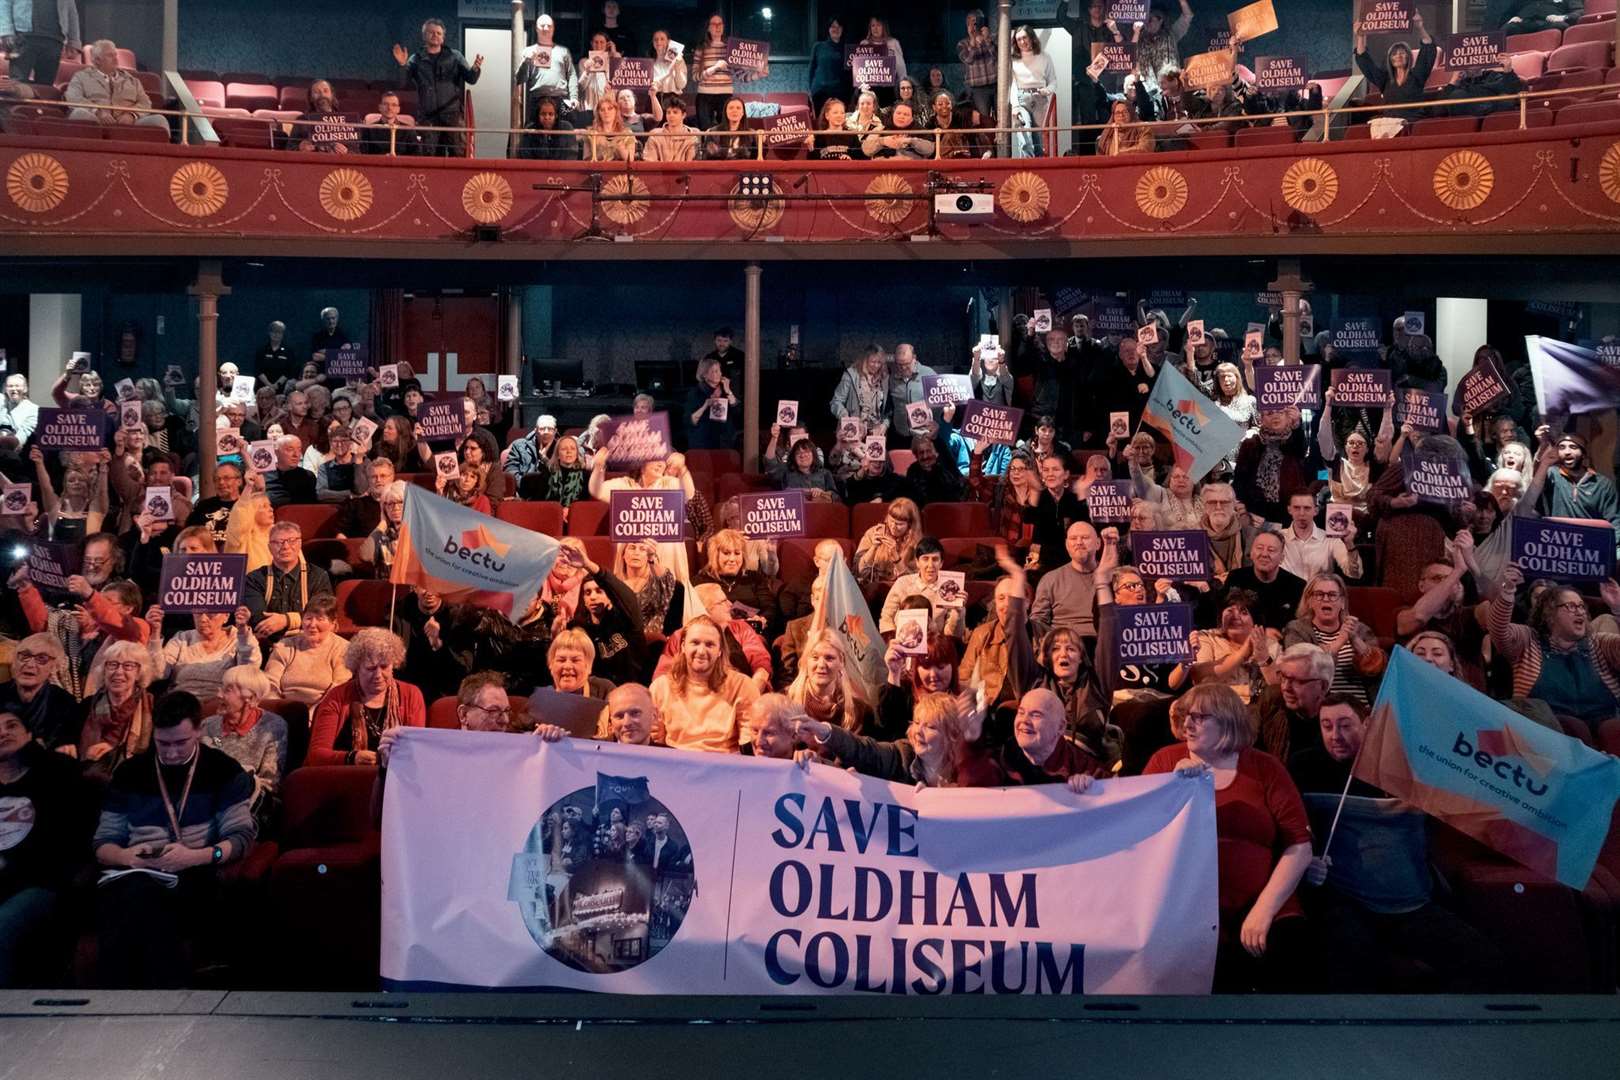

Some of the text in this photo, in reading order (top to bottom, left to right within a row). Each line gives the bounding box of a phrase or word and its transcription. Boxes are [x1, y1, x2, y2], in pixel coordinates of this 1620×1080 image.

[1111, 4, 1144, 12] OLDHAM
[1375, 2, 1399, 12] SAVE
[1108, 12, 1147, 20] COLISEUM
[1366, 11, 1407, 21] OLDHAM
[1362, 20, 1409, 30] COLISEUM
[739, 41, 758, 51] SAVE
[1462, 36, 1489, 47] SAVE
[731, 49, 764, 60] OLDHAM
[1104, 46, 1124, 55] SAVE
[1453, 45, 1498, 56] OLDHAM
[620, 61, 641, 70] SAVE
[728, 56, 765, 68] COLISEUM
[864, 59, 883, 67] SAVE
[1270, 59, 1293, 69] SAVE
[614, 69, 648, 78] OLDHAM
[858, 67, 890, 75] OLDHAM
[1262, 68, 1302, 78] OLDHAM
[611, 77, 651, 87] COLISEUM
[855, 74, 892, 83] COLISEUM
[1259, 77, 1304, 88] COLISEUM
[322, 115, 346, 125] SAVE
[776, 115, 798, 127] SAVE
[312, 131, 358, 143] COLISEUM
[1344, 321, 1368, 331] SAVE
[1336, 330, 1376, 340] OLDHAM
[1333, 338, 1379, 348] COLISEUM
[338, 352, 357, 361] SAVE
[330, 359, 363, 368] OLDHAM
[328, 367, 366, 376] COLISEUM
[1273, 371, 1303, 382] SAVE
[937, 376, 958, 387] SAVE
[1347, 373, 1374, 383] SAVE
[1464, 369, 1485, 389] SAVE
[929, 386, 967, 396] OLDHAM
[1264, 381, 1314, 393] OLDHAM
[1338, 382, 1383, 393] OLDHAM
[1463, 375, 1495, 402] OLDHAM
[927, 393, 970, 405] COLISEUM
[1261, 392, 1318, 404] COLISEUM
[1335, 391, 1387, 403] COLISEUM
[1405, 394, 1430, 406] SAVE
[1465, 383, 1504, 412] COLISEUM
[429, 405, 451, 416] SAVE
[982, 407, 1007, 421] SAVE
[56, 414, 87, 425] SAVE
[422, 414, 459, 426] OLDHAM
[970, 414, 1014, 431] OLDHAM
[1166, 399, 1201, 435] bectu
[45, 424, 97, 436] OLDHAM
[964, 423, 1015, 442] COLISEUM
[40, 435, 100, 447] COLISEUM
[1420, 461, 1449, 475] SAVE
[1413, 471, 1463, 488] OLDHAM
[1089, 485, 1117, 496] SAVE
[1410, 482, 1469, 499] COLISEUM
[631, 497, 663, 510] SAVE
[756, 497, 786, 510] SAVE
[1089, 496, 1127, 507] LDHAM
[619, 510, 675, 523] OLDHAM
[747, 508, 797, 523] OLDHAM
[1089, 506, 1132, 517] OLISEUM
[614, 523, 680, 537] COLISEUM
[744, 520, 801, 534] COLISEUM
[1152, 537, 1186, 550] SAVE
[1540, 530, 1584, 547] SAVE
[443, 535, 506, 573] bectu
[1142, 550, 1199, 562] OLDHAM
[1524, 542, 1600, 564] OLDHAM
[185, 561, 222, 576] SAVE
[1138, 562, 1205, 575] COLISEUM
[1518, 556, 1606, 577] COLISEUM
[30, 568, 67, 588] COLISEU
[171, 576, 234, 591] OLDHAM
[164, 591, 237, 606] COLISEUM
[1133, 611, 1169, 627] SAVE
[1122, 625, 1183, 642] OLDHAM
[1120, 640, 1189, 658] COLISEUM
[1452, 731, 1549, 796] bectu
[1418, 744, 1569, 830] the union for creative ambition
[771, 792, 920, 858] SAVE
[768, 859, 1040, 929] OLDHAM
[764, 928, 1087, 996] COLISEUM
